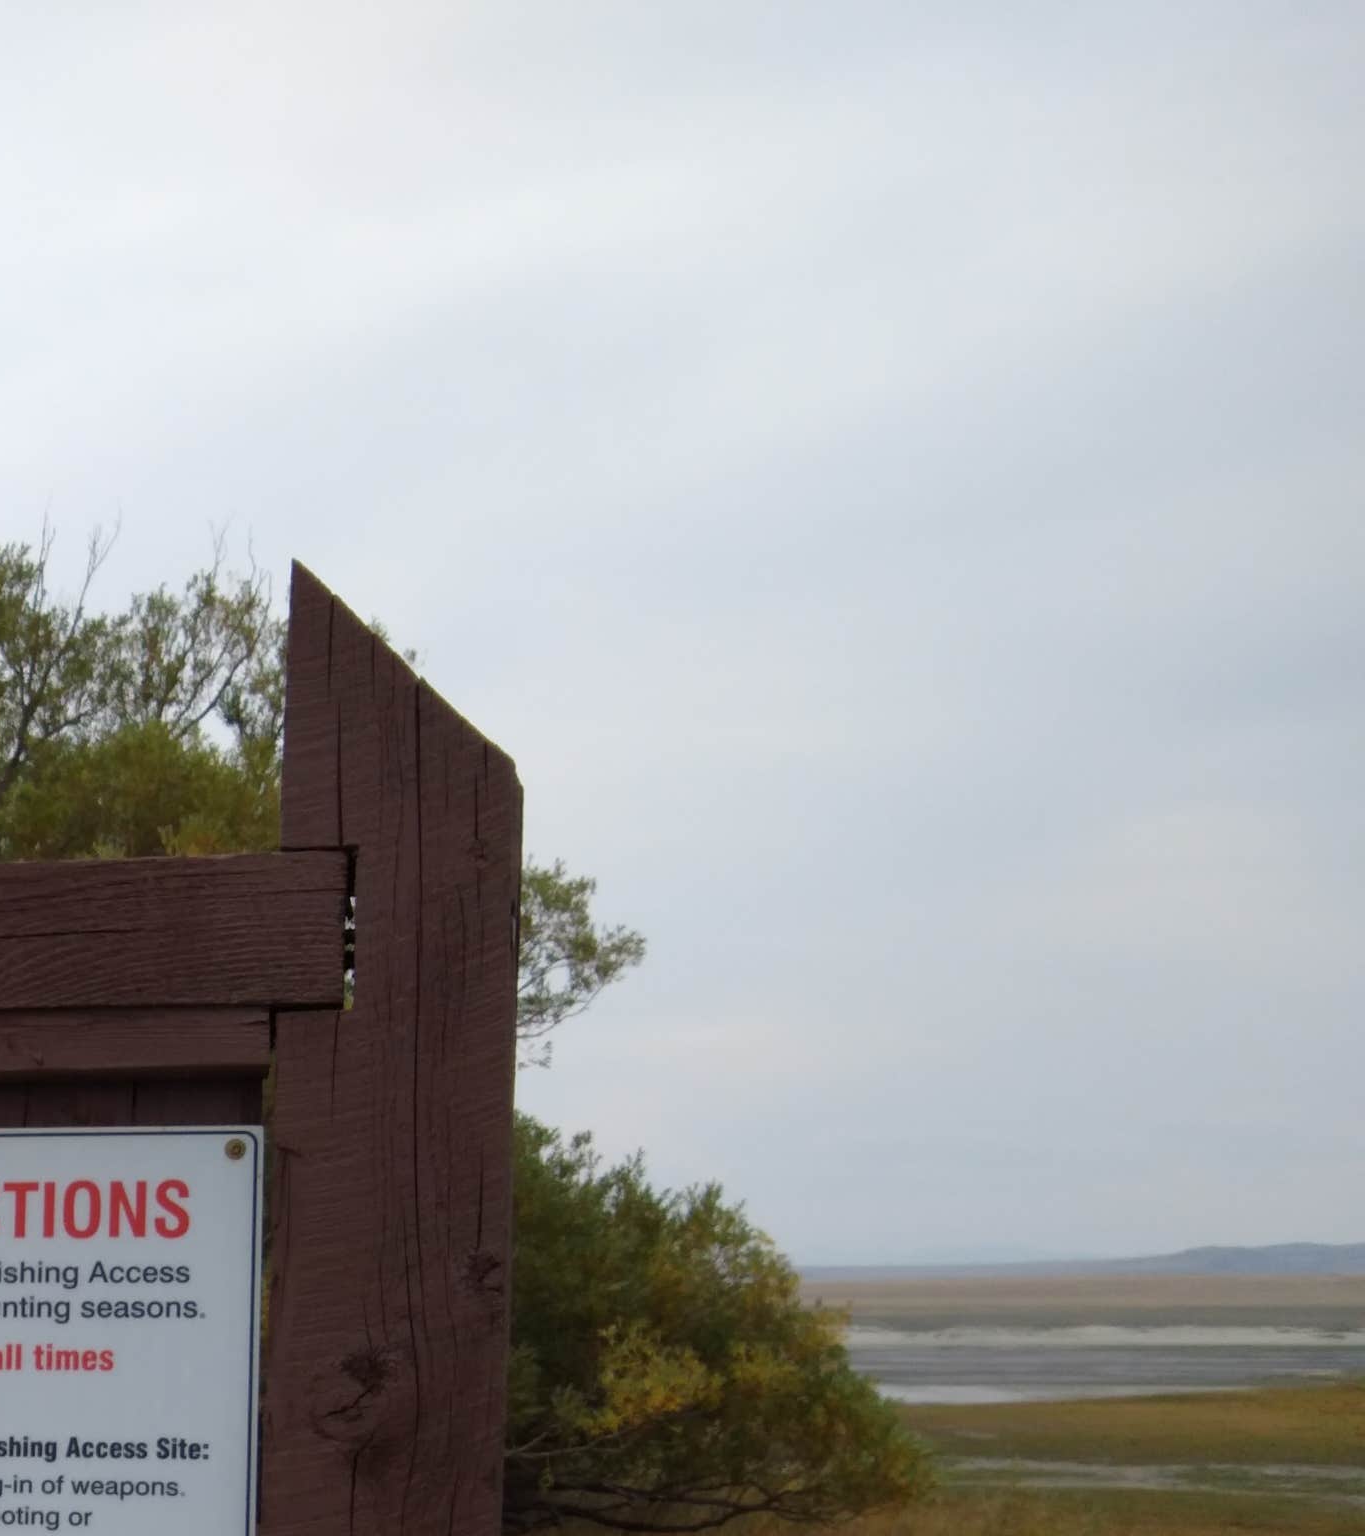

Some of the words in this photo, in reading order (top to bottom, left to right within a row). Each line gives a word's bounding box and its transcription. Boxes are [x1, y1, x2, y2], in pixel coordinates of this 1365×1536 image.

[88, 1261, 190, 1283] Access
[80, 1300, 204, 1318] seasons.
[33, 1343, 113, 1371] times
[66, 1436, 147, 1459] Access
[156, 1437, 208, 1460] Site:
[41, 1475, 64, 1494] of
[71, 1480, 184, 1500] weapons.
[68, 1511, 92, 1526] or
